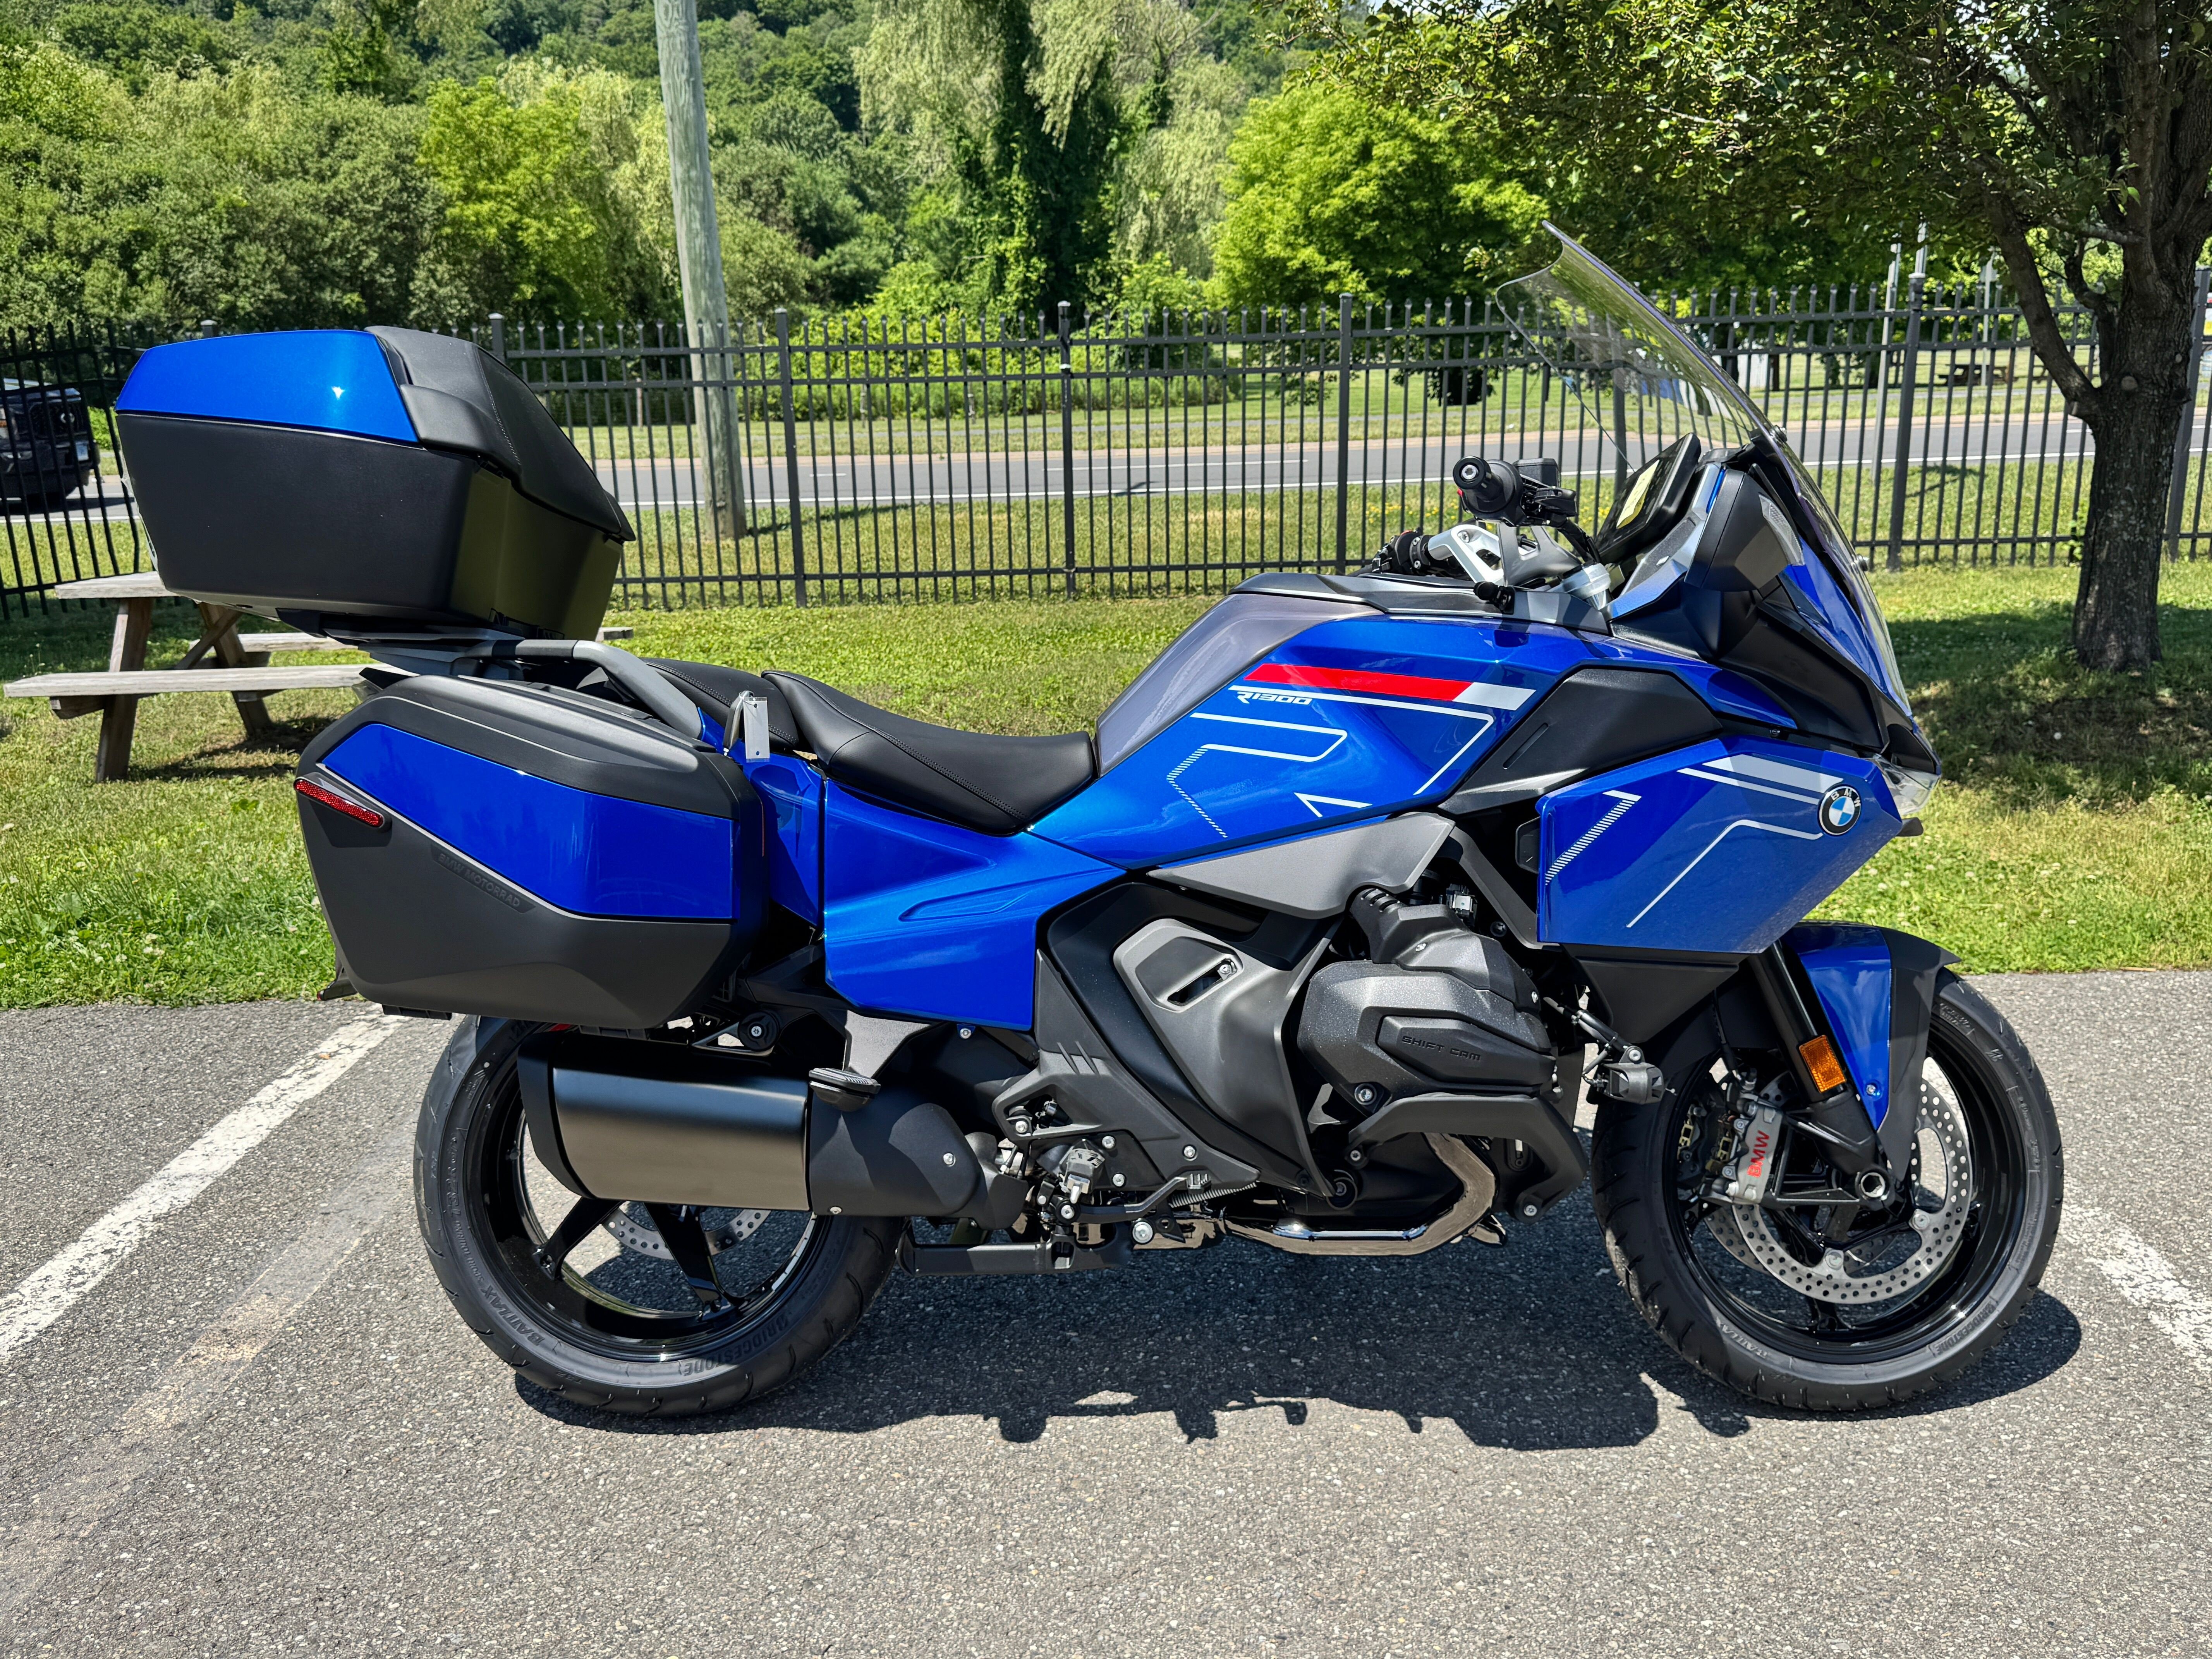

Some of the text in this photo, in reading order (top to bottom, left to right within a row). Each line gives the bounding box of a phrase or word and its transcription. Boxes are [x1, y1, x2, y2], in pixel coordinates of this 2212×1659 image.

[1831, 788, 1861, 807] BMW
[438, 853, 520, 907] BMW MOTORRAD
[1402, 1035, 1481, 1061] SHIFT CAM
[1747, 1130, 1770, 1178] BMW
[480, 1285, 545, 1346] BATTLAX
